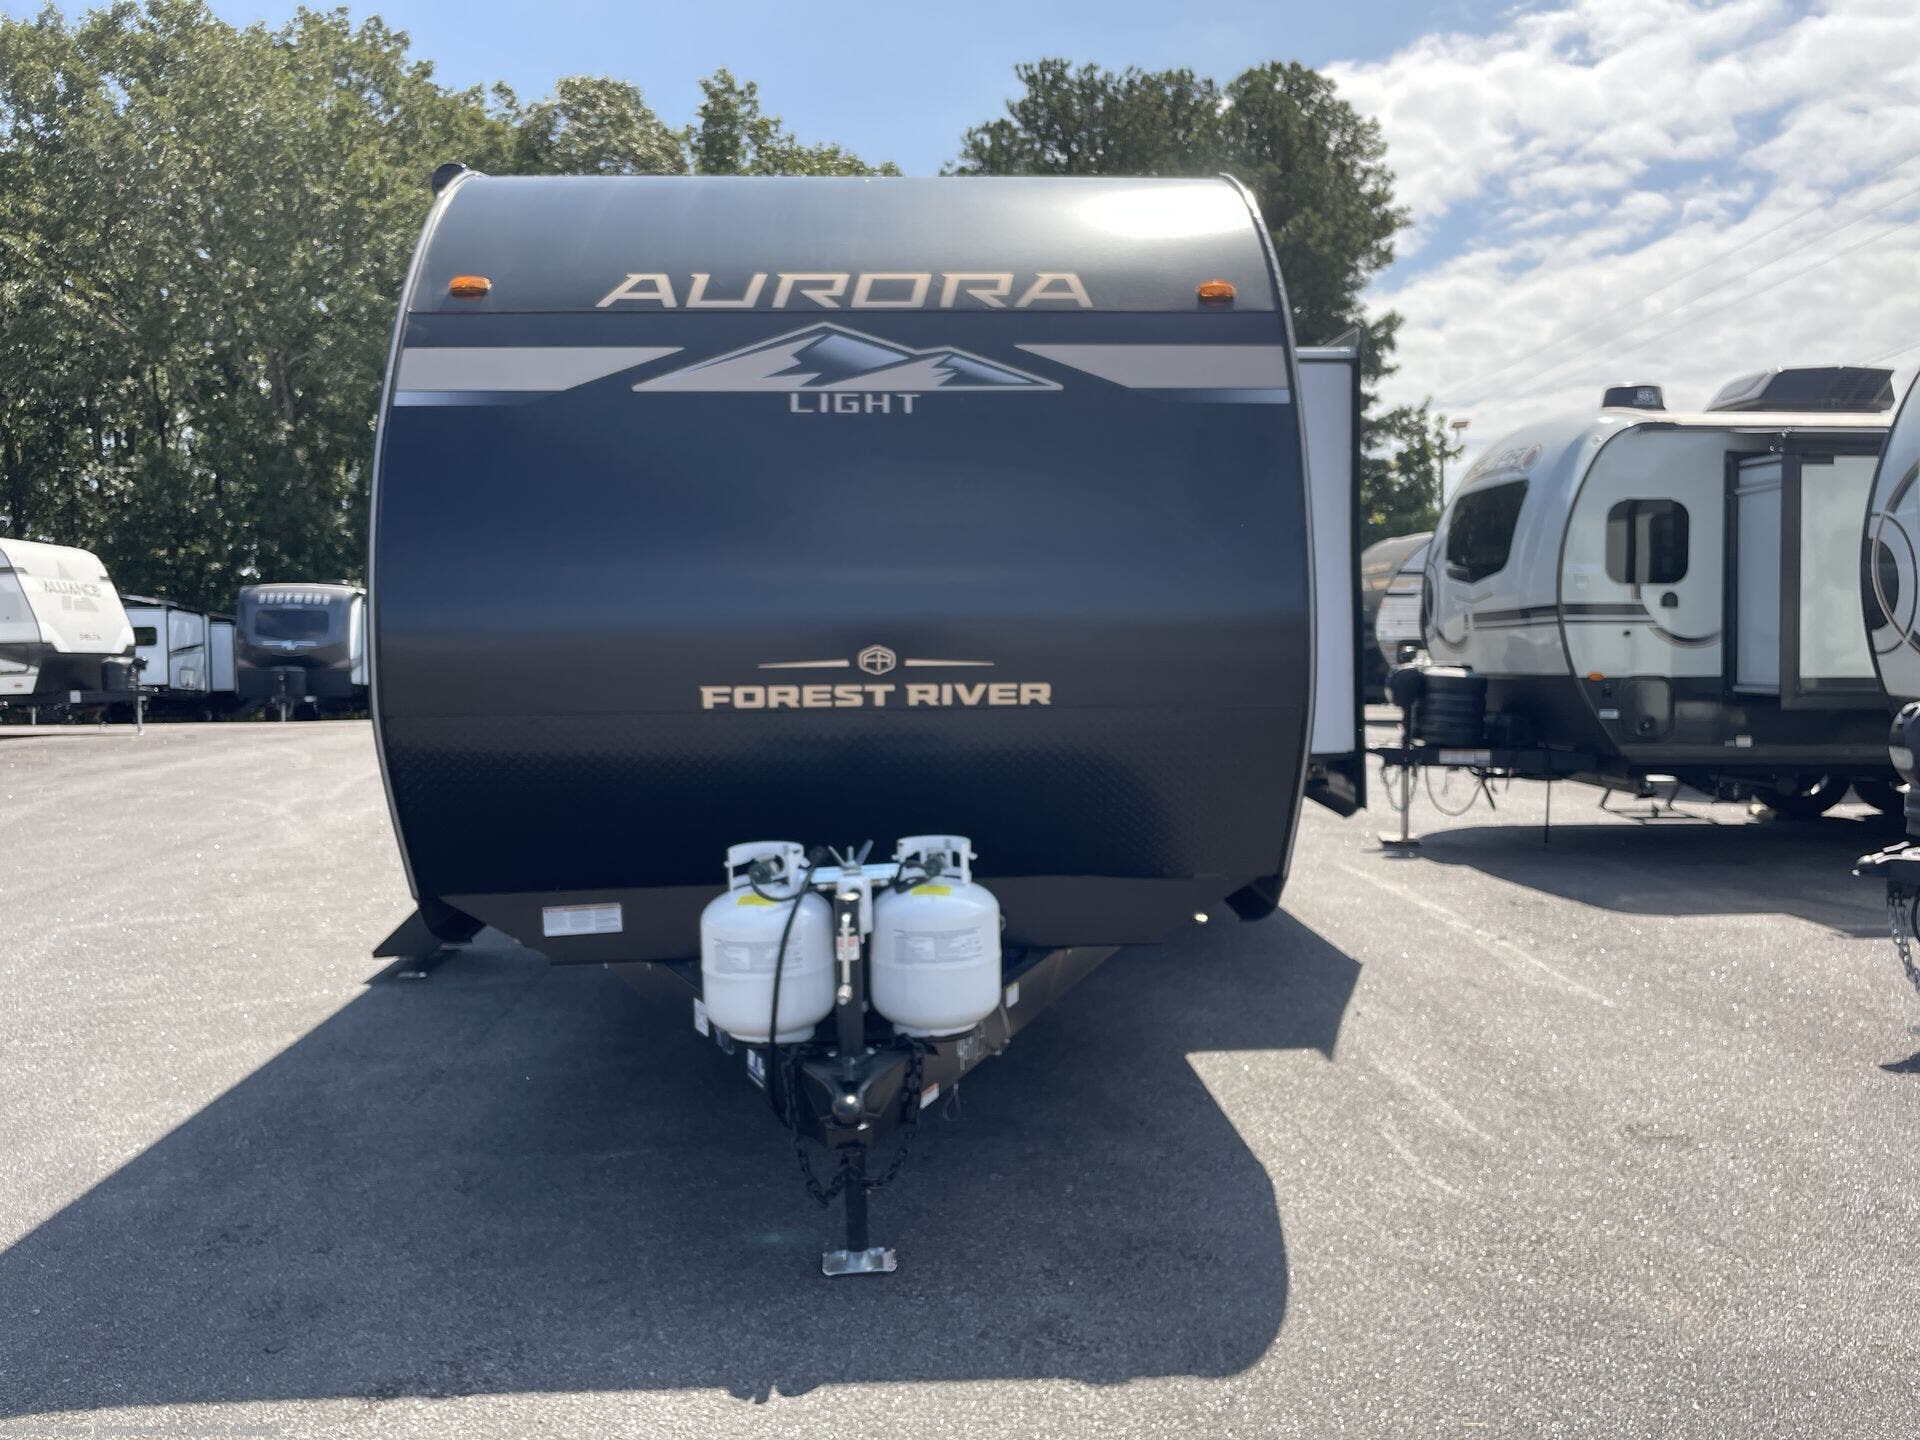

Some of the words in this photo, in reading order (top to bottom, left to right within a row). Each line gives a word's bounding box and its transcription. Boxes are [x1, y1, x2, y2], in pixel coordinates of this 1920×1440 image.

[595, 273, 1094, 308] AURORA
[790, 393, 920, 414] LIGHT
[700, 684, 896, 709] FOREST
[905, 682, 1052, 706] RIVER
